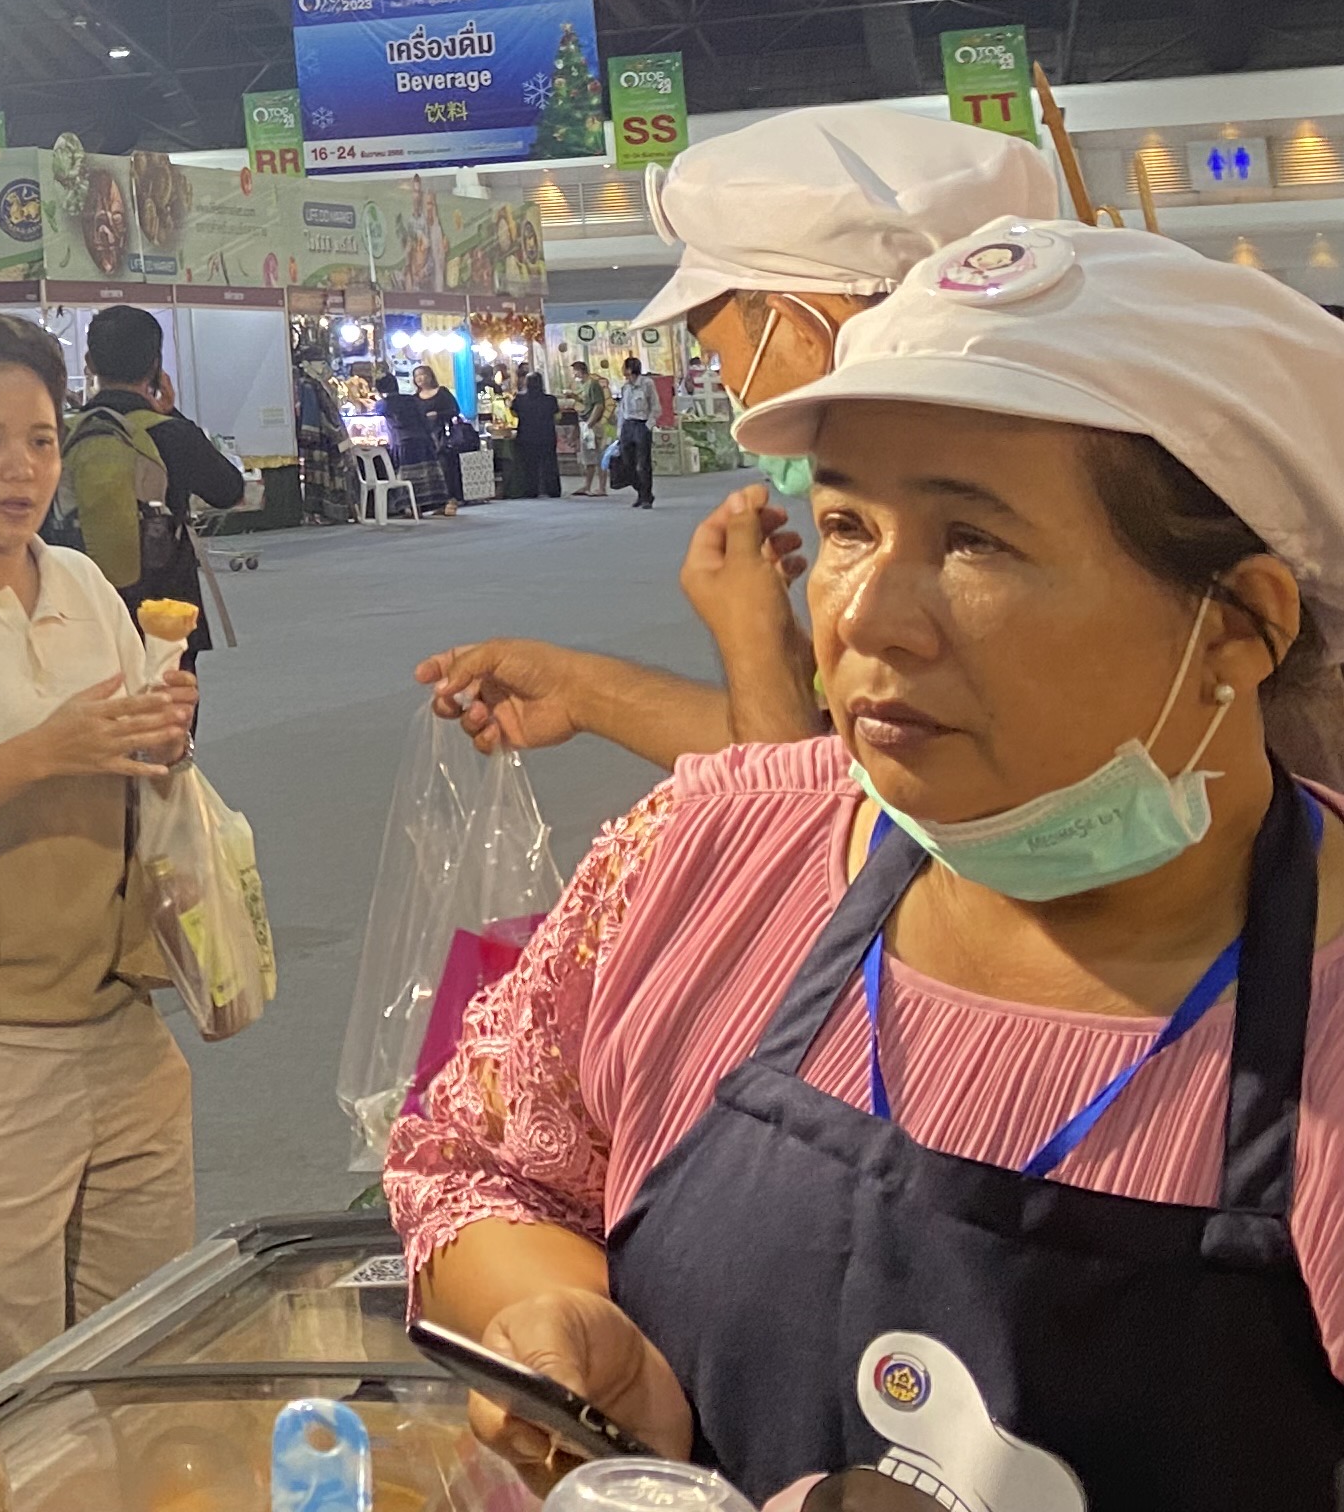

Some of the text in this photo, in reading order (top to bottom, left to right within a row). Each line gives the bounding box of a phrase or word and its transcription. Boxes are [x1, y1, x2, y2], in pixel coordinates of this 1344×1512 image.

[388, 21, 493, 62] เครื่องดื่ม
[396, 69, 492, 93] Beverage
[424, 100, 469, 123] 饮料
[963, 92, 1018, 124] TT
[623, 114, 678, 145] SS
[256, 148, 301, 175] RR
